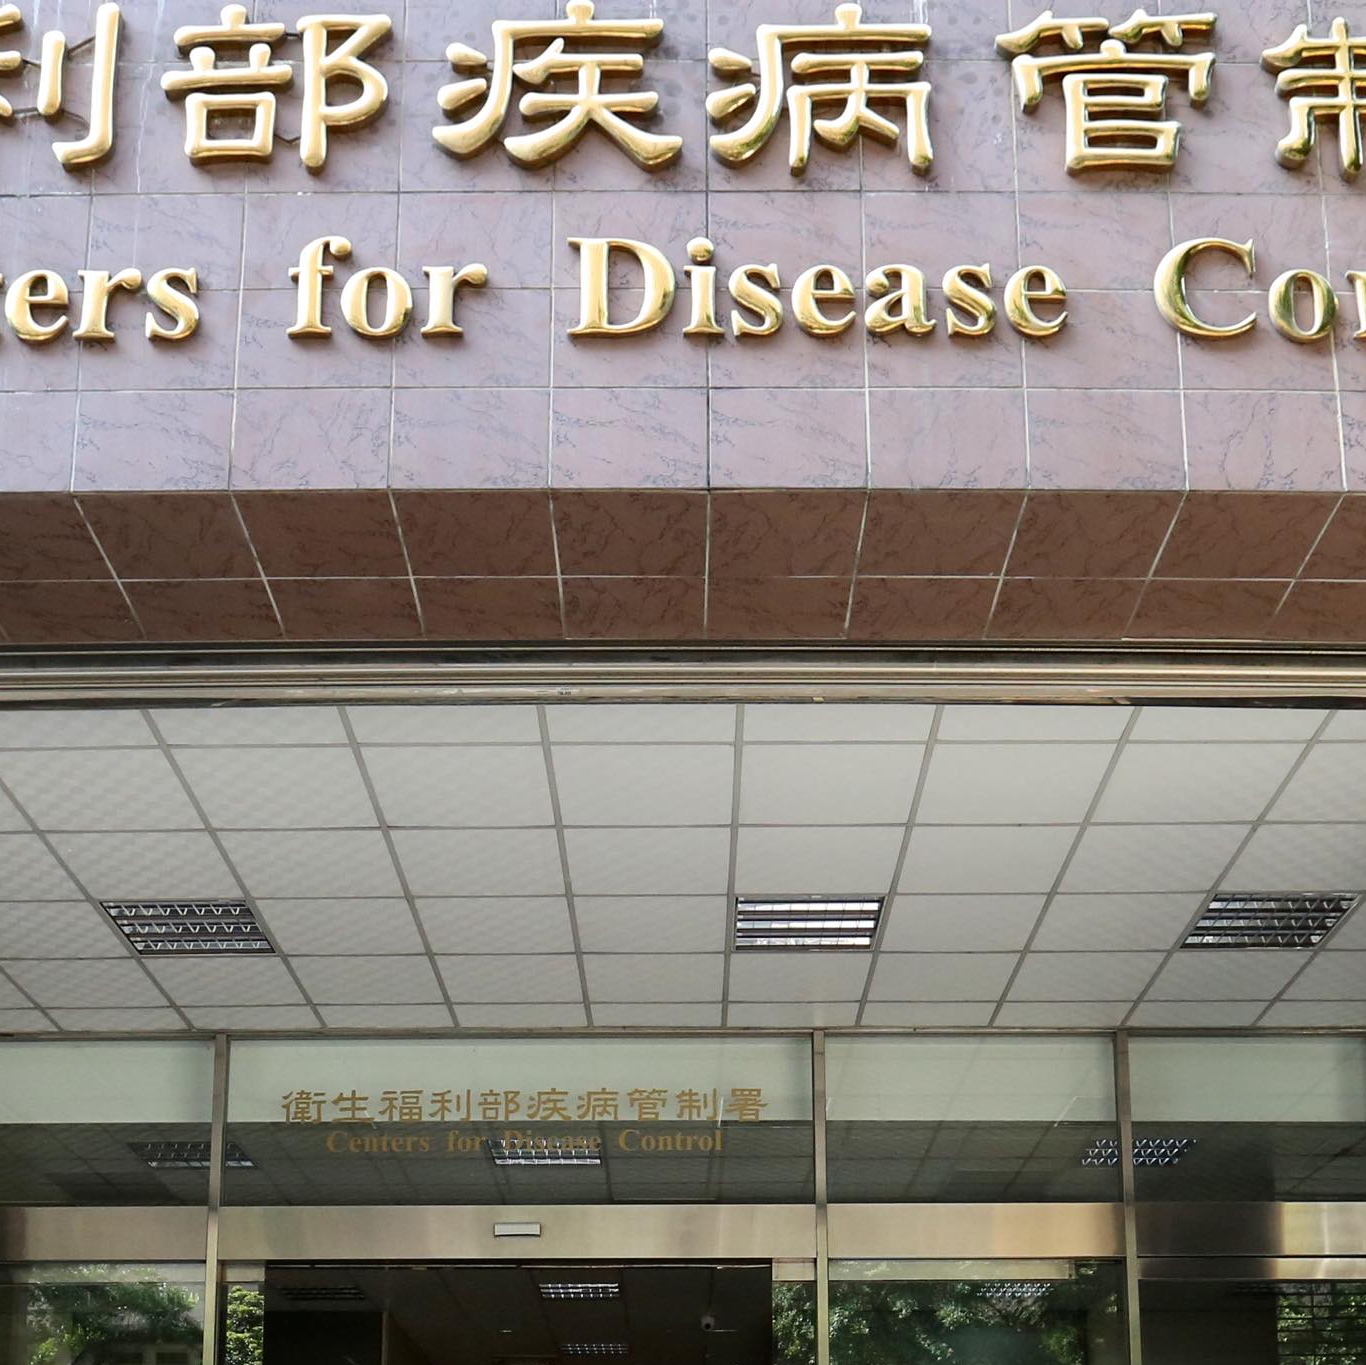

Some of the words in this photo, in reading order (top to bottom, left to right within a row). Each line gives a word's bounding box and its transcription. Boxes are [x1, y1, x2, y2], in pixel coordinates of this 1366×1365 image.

[287, 234, 490, 342] for
[565, 236, 1071, 343] Disease
[281, 1087, 770, 1126] 衛生福利部疾病管制署
[326, 1130, 431, 1153] Centers
[447, 1130, 487, 1152] for
[502, 1130, 602, 1152] Disease
[618, 1128, 723, 1152] Control
